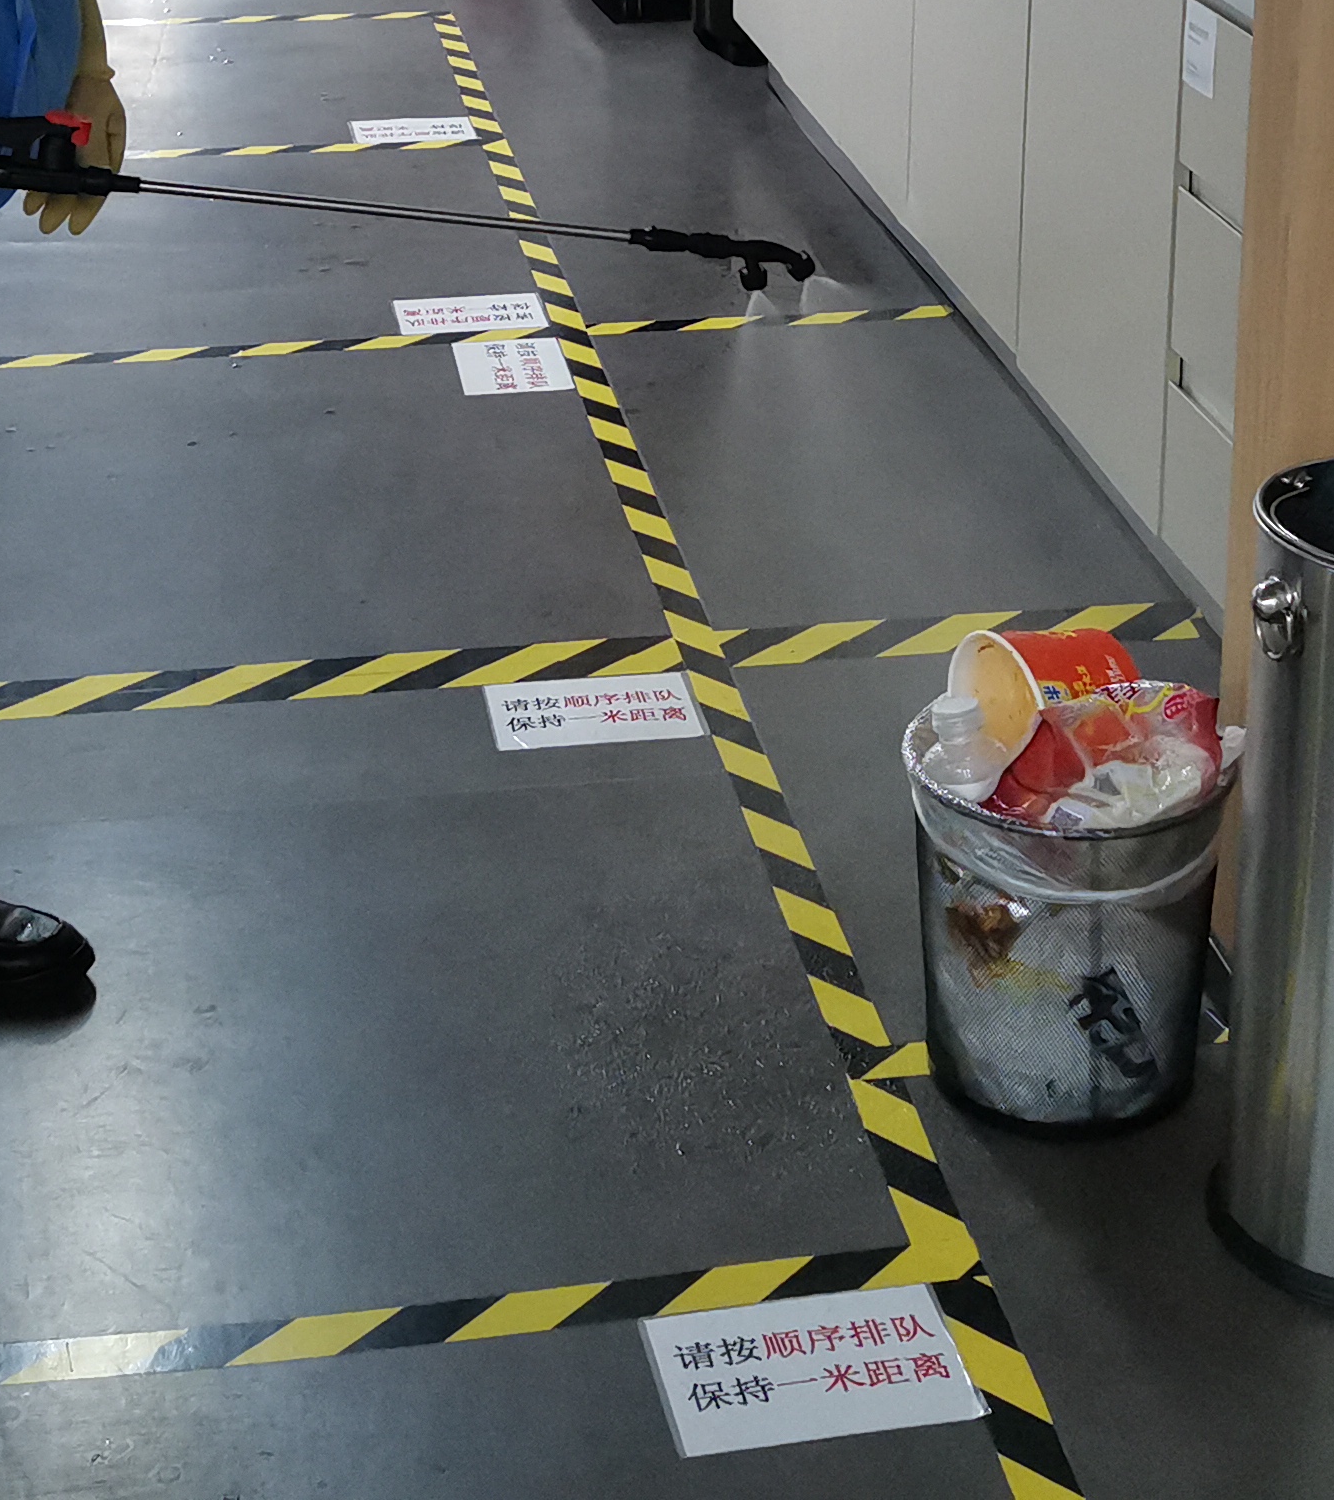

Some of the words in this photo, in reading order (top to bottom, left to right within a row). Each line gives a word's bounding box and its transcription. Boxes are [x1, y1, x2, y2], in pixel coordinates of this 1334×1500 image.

[501, 688, 683, 713] 请按顺序排队
[505, 706, 687, 733] 保持一米距离
[672, 1313, 937, 1372] 请按顺序排队
[687, 1351, 952, 1413] 保持一米距离
